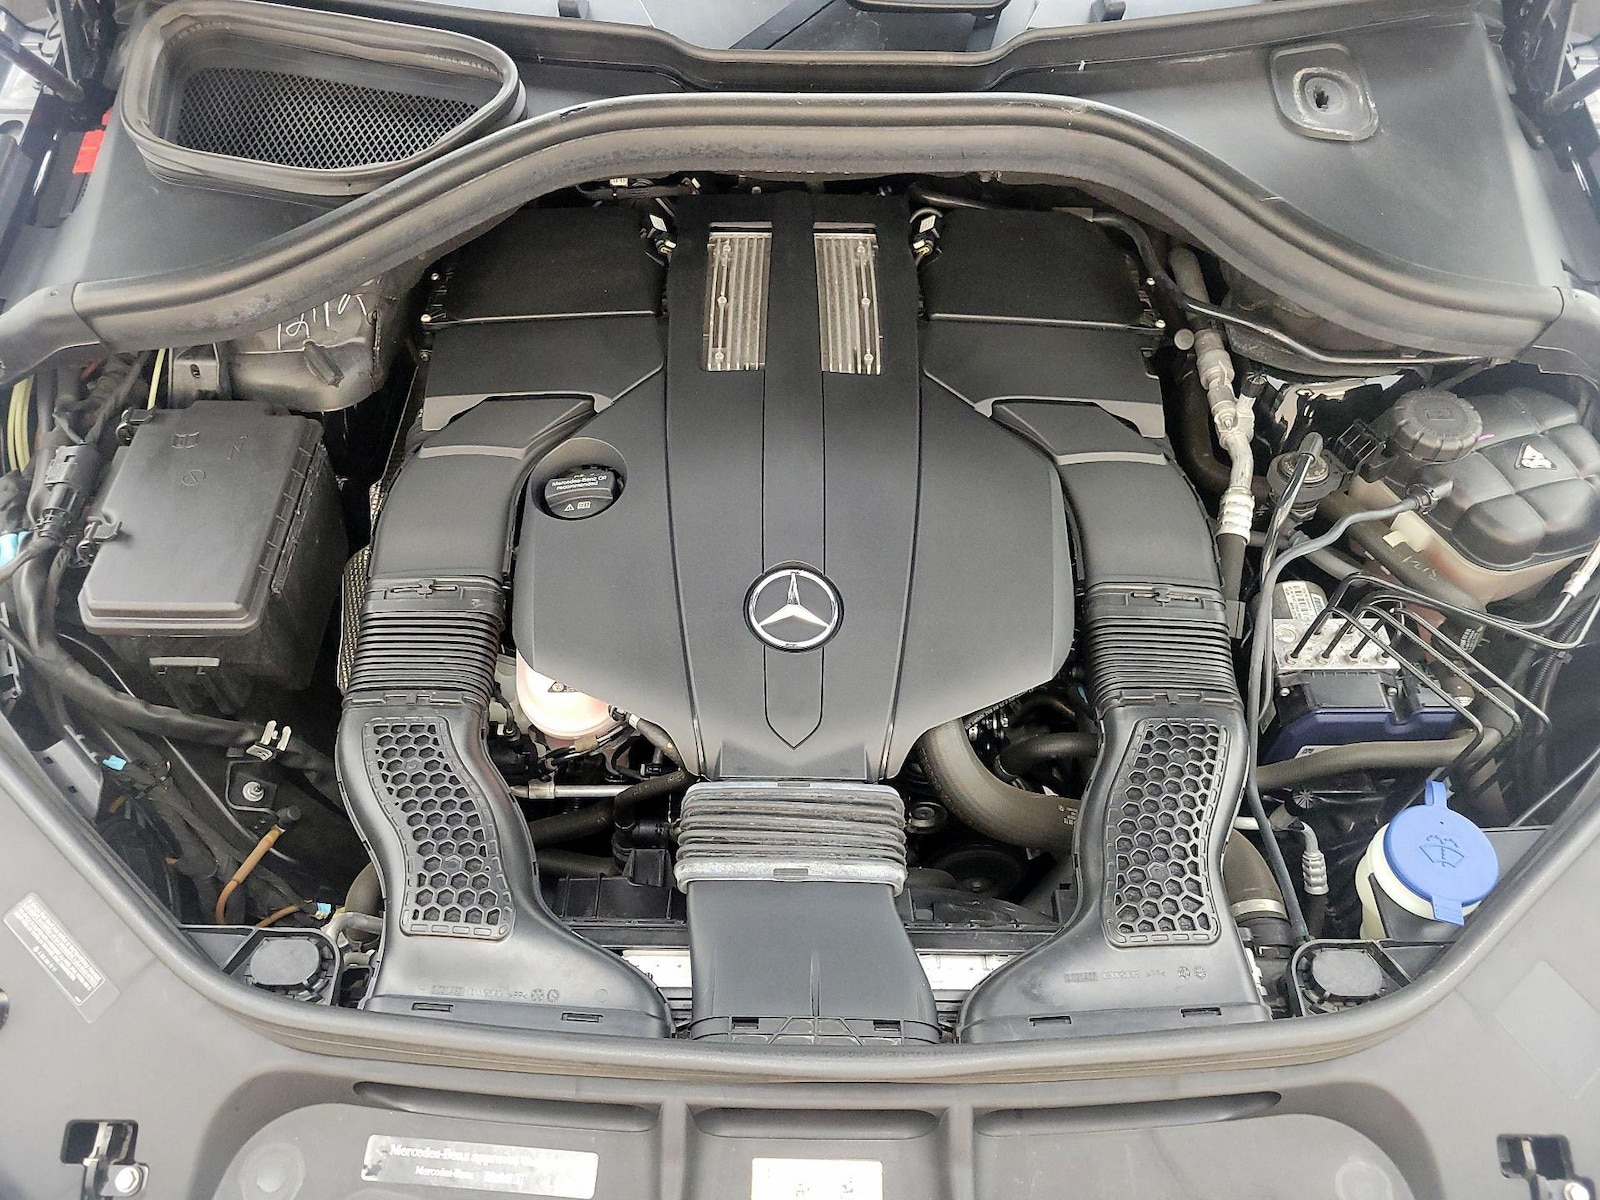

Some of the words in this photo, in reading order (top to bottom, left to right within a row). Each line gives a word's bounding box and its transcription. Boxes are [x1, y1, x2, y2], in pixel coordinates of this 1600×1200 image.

[551, 476, 597, 487] Mercedes-Benz
[556, 481, 599, 490] recommended
[389, 1143, 470, 1162] Mercedes-Benz
